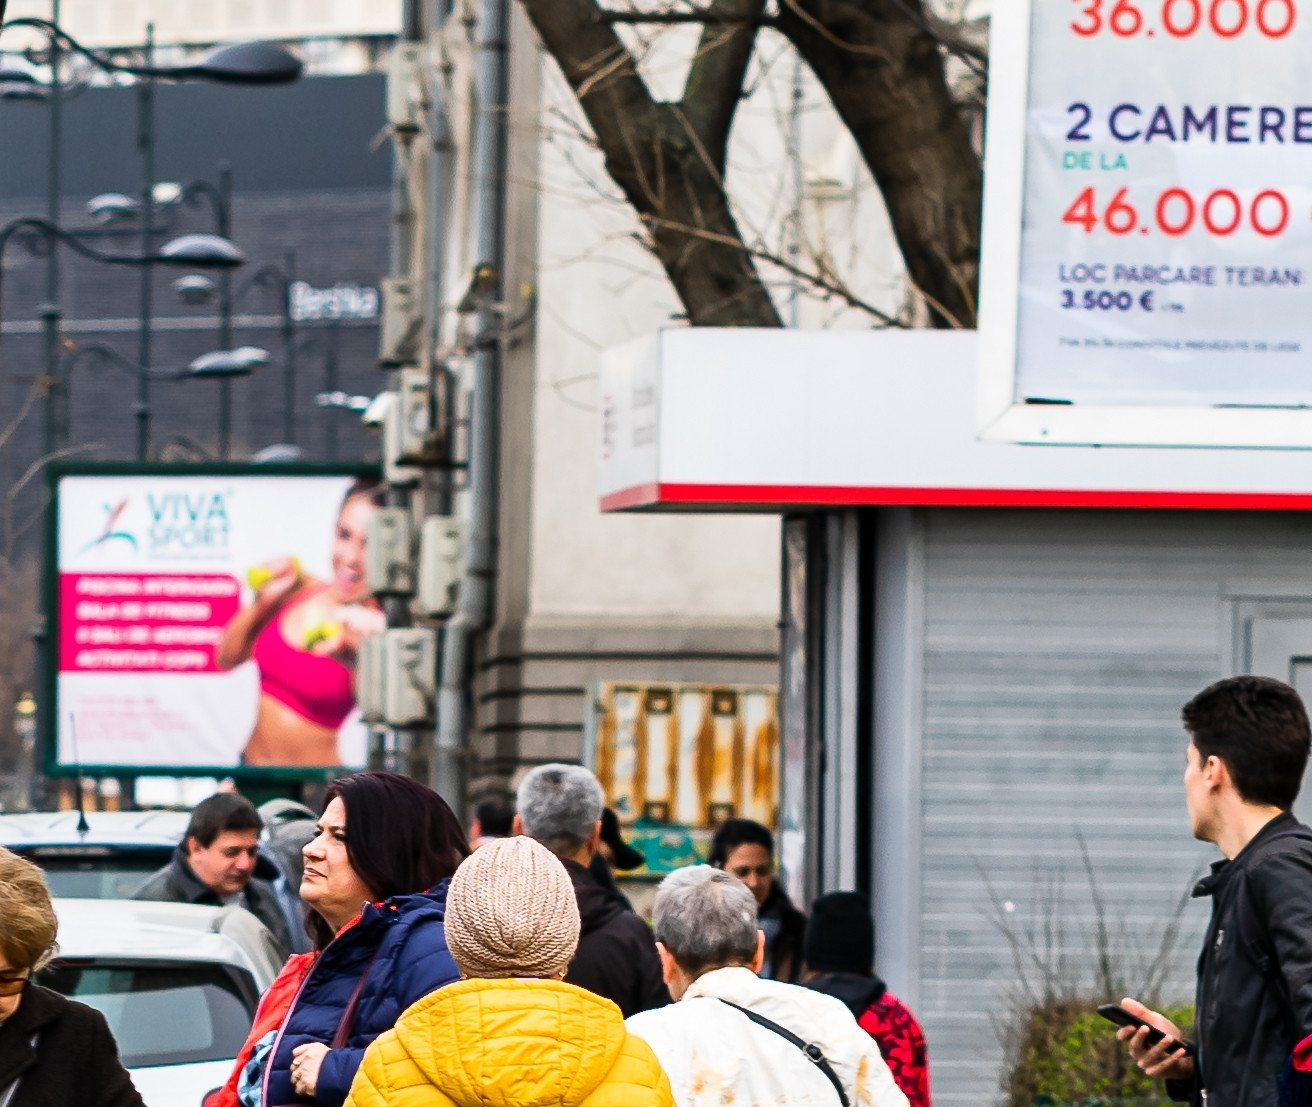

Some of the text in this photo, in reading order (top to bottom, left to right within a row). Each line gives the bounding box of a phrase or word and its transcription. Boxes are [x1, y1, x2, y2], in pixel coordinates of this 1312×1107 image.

[1069, 0, 1296, 38] 36.000
[1066, 103, 1092, 142] 2
[1063, 151, 1128, 170] DE LA
[1062, 187, 1290, 236] 46.000
[1059, 263, 1302, 287] LOC PARCARE TERAN
[1061, 289, 1133, 311] 3.500
[146, 493, 228, 523] VIVA
[146, 523, 232, 550] SPORT
